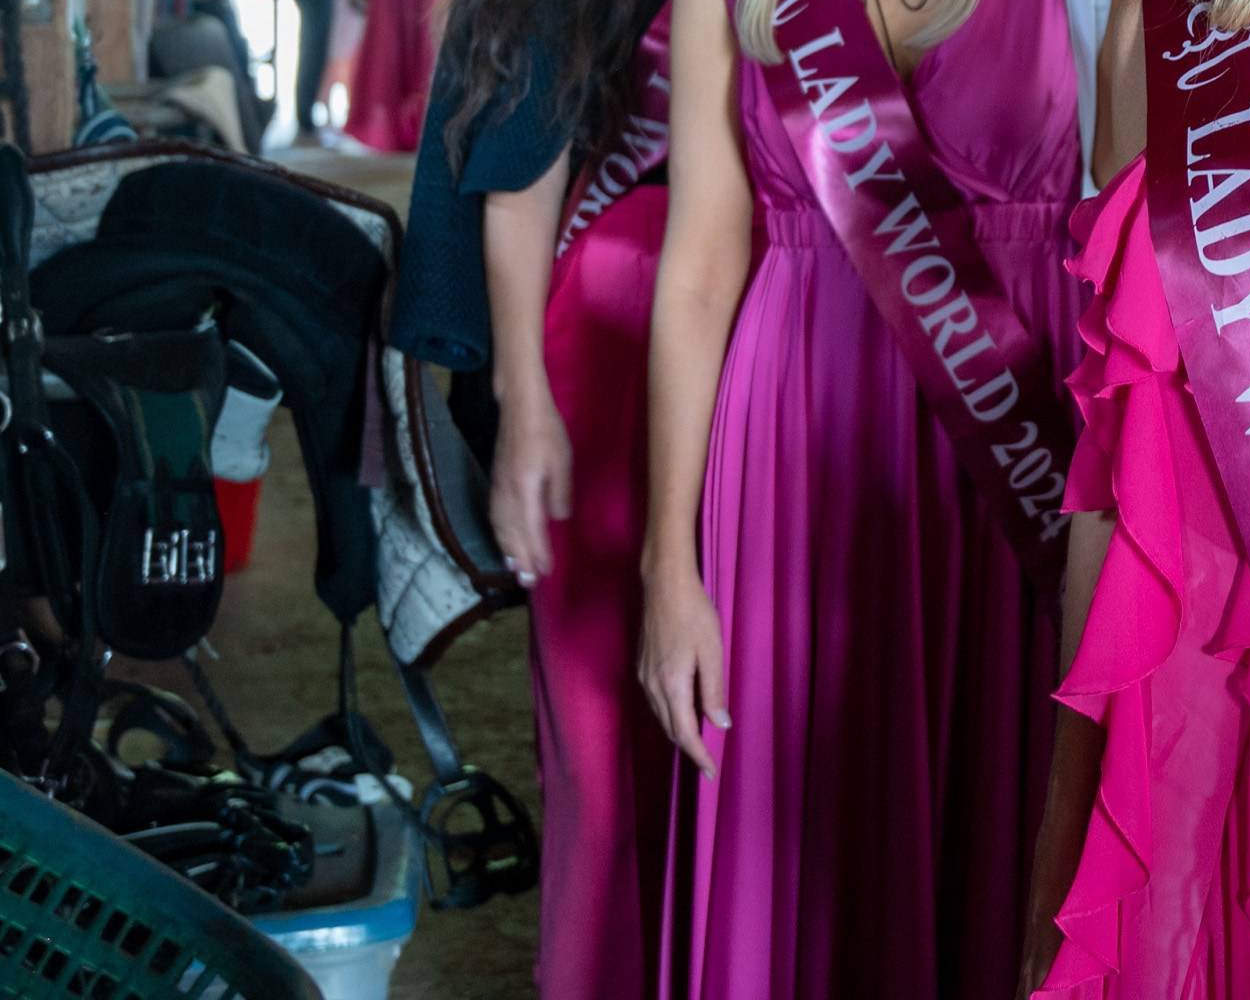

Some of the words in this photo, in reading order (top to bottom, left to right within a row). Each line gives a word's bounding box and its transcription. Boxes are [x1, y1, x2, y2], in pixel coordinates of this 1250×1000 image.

[788, 27, 906, 190] LADY
[872, 191, 1019, 422] WORLD
[990, 420, 1073, 542] 2024
